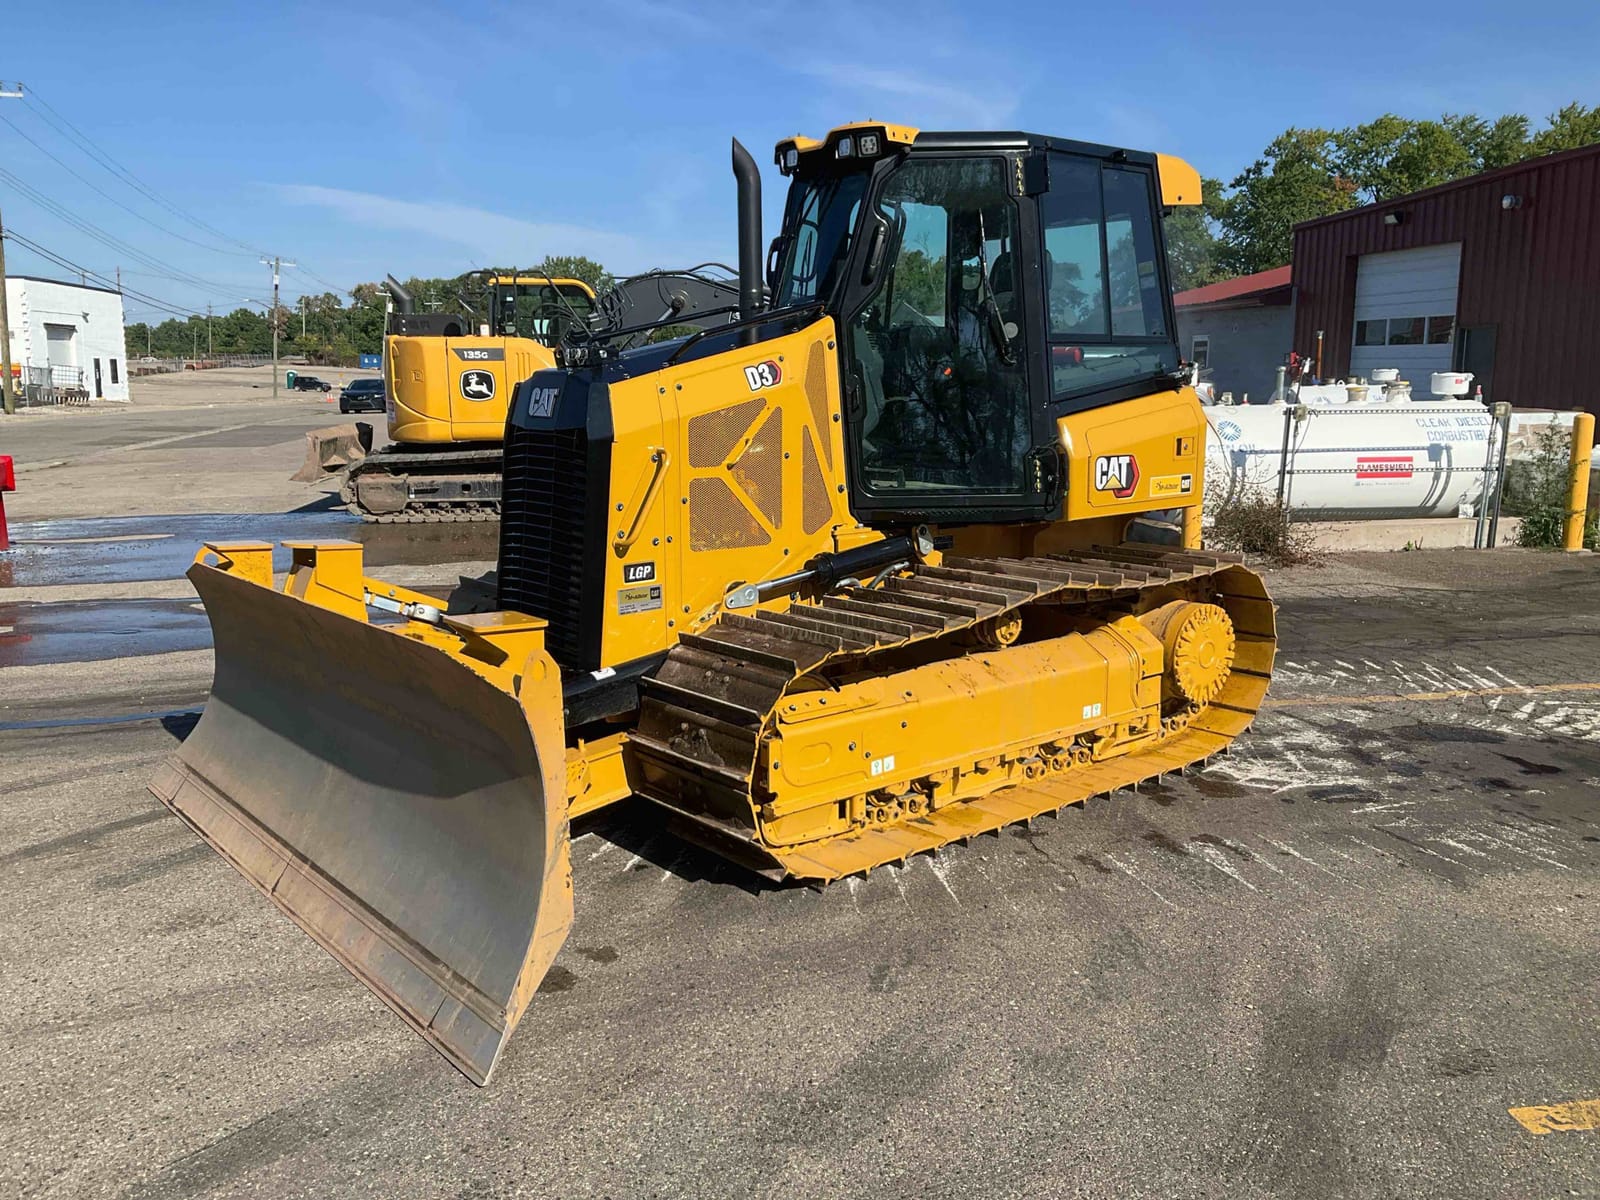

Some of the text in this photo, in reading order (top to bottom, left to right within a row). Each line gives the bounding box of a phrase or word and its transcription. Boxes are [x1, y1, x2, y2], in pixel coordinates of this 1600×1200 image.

[463, 350, 488, 359] 135G
[744, 362, 773, 390] D3
[529, 387, 560, 417] CAT
[1456, 416, 1493, 426] DIESEL
[1427, 430, 1490, 441] COMBUSTIBL
[1096, 456, 1131, 490] CAT
[629, 565, 651, 580] LGP
